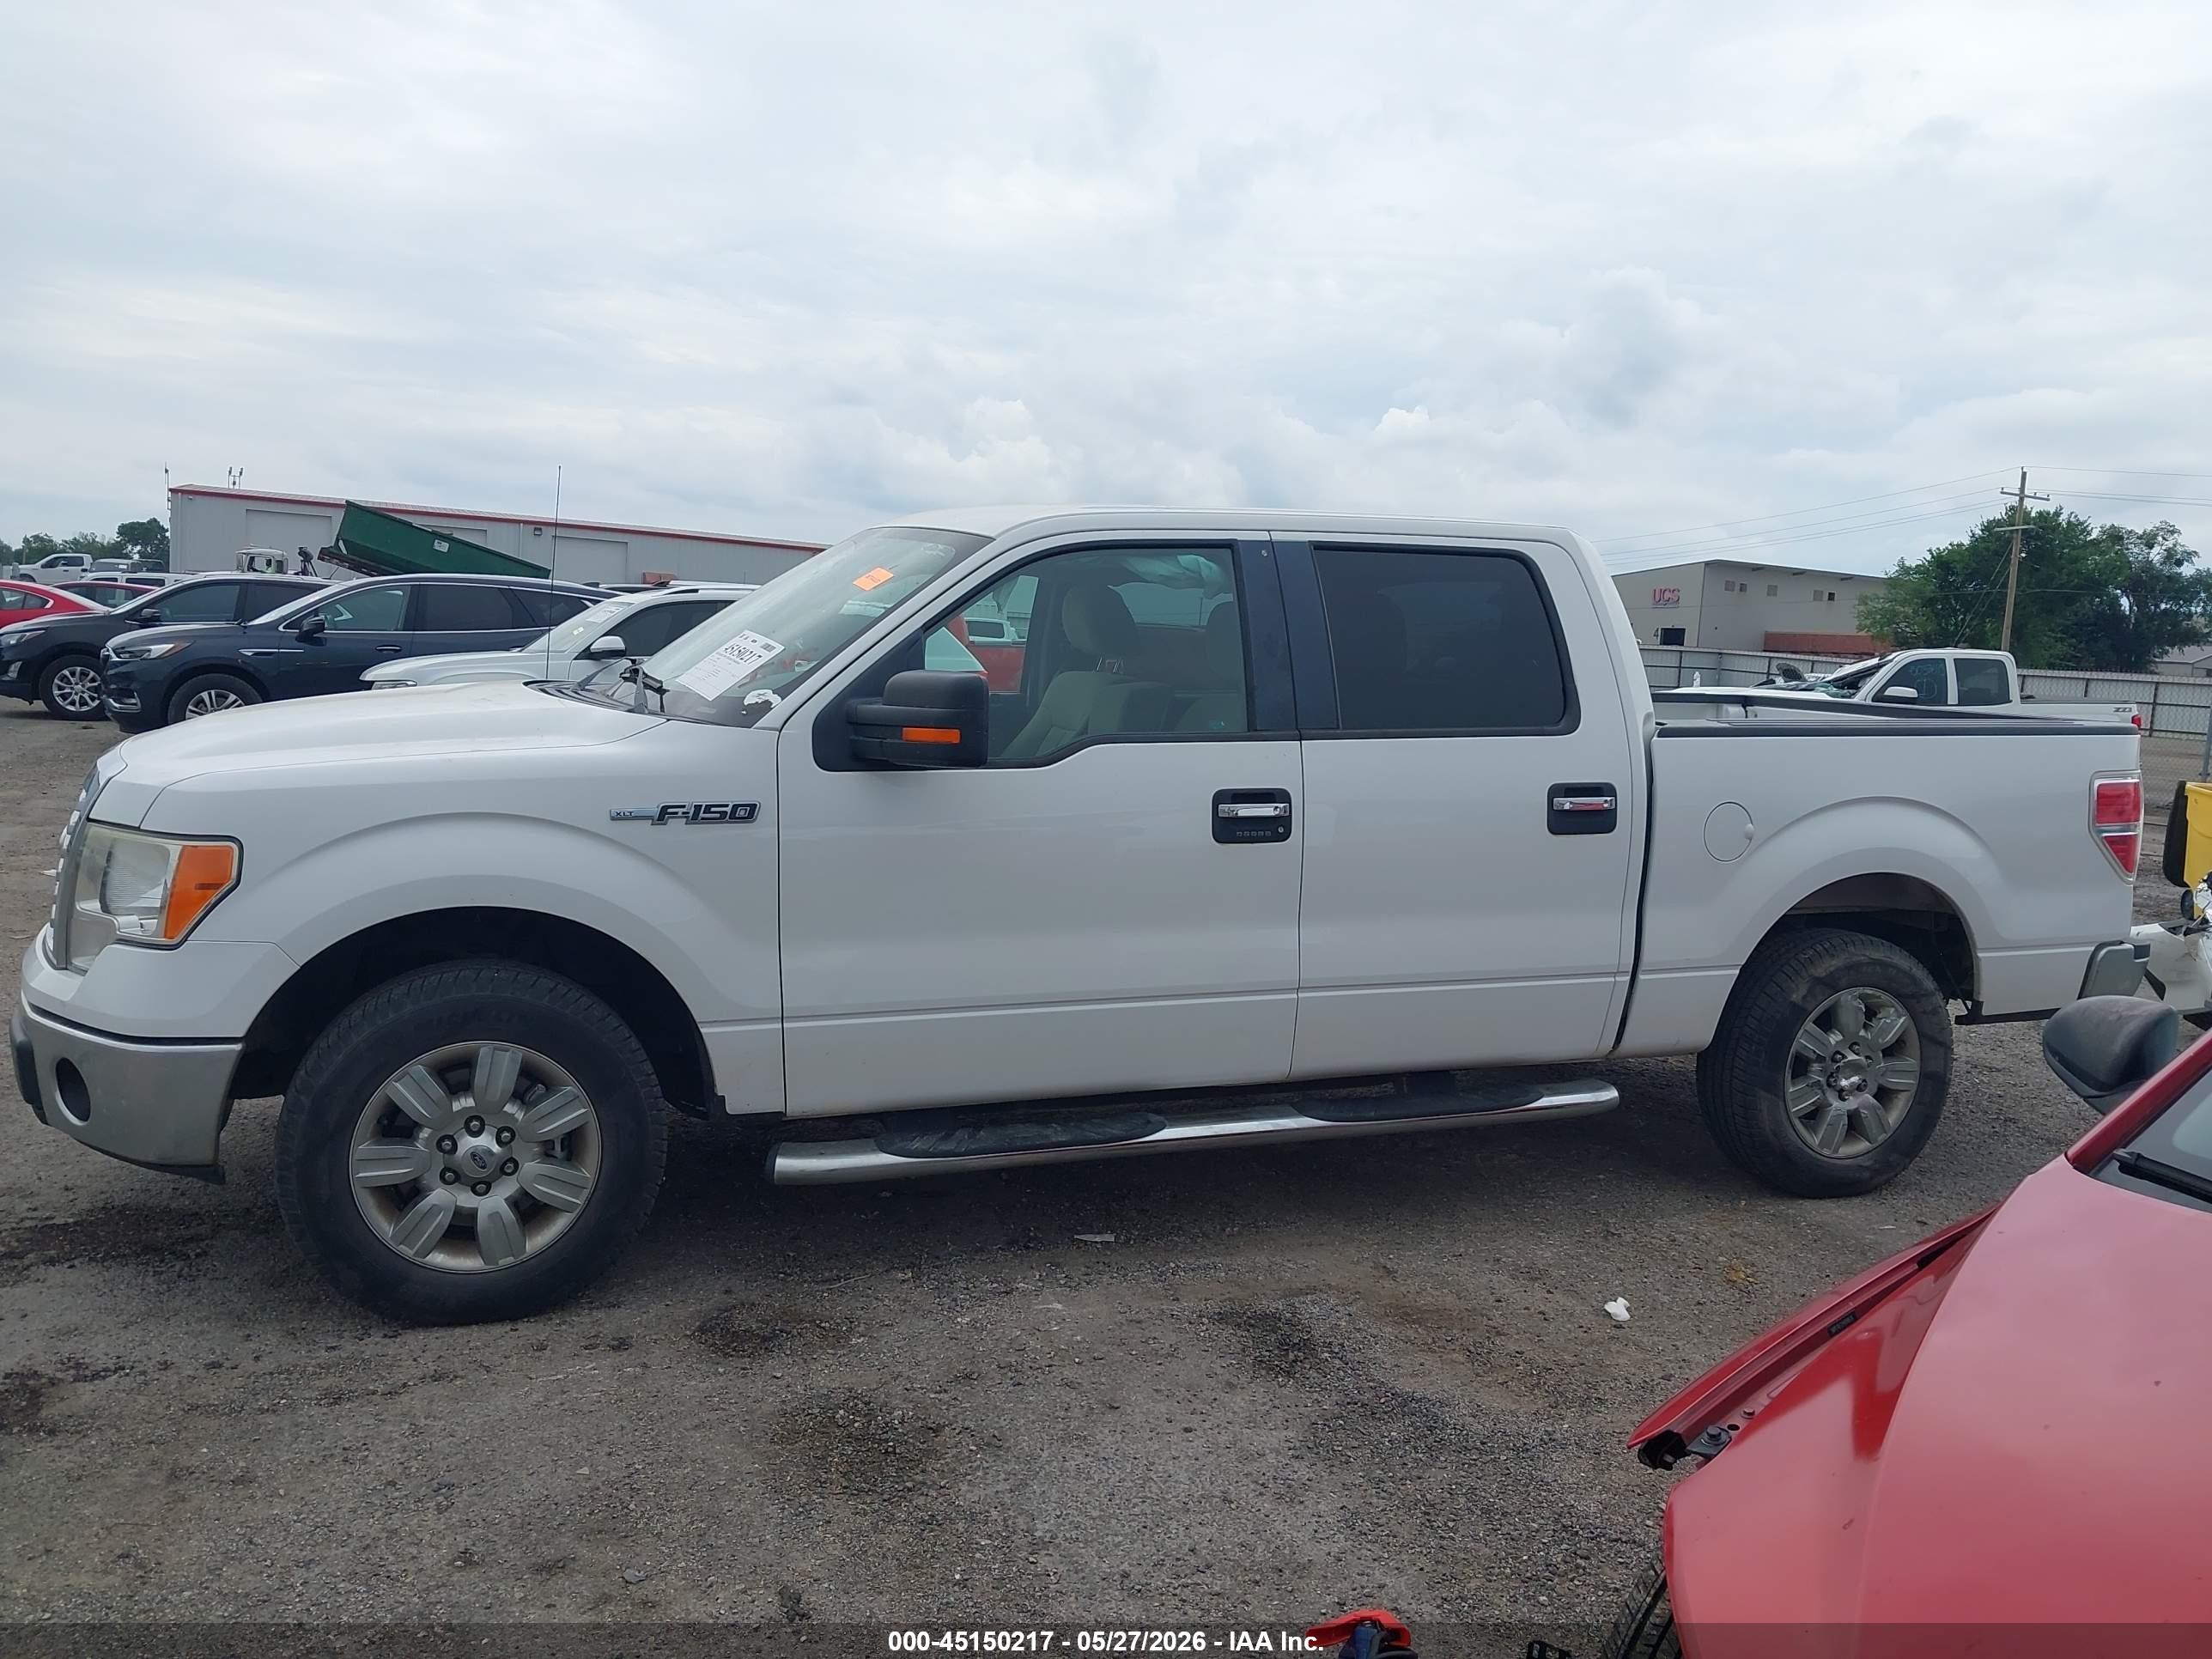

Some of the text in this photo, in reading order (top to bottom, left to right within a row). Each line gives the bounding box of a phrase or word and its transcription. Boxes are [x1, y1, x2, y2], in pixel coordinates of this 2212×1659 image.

[1653, 587, 1680, 605] UCS
[1653, 627, 1660, 641] 4
[655, 802, 759, 823] F-150
